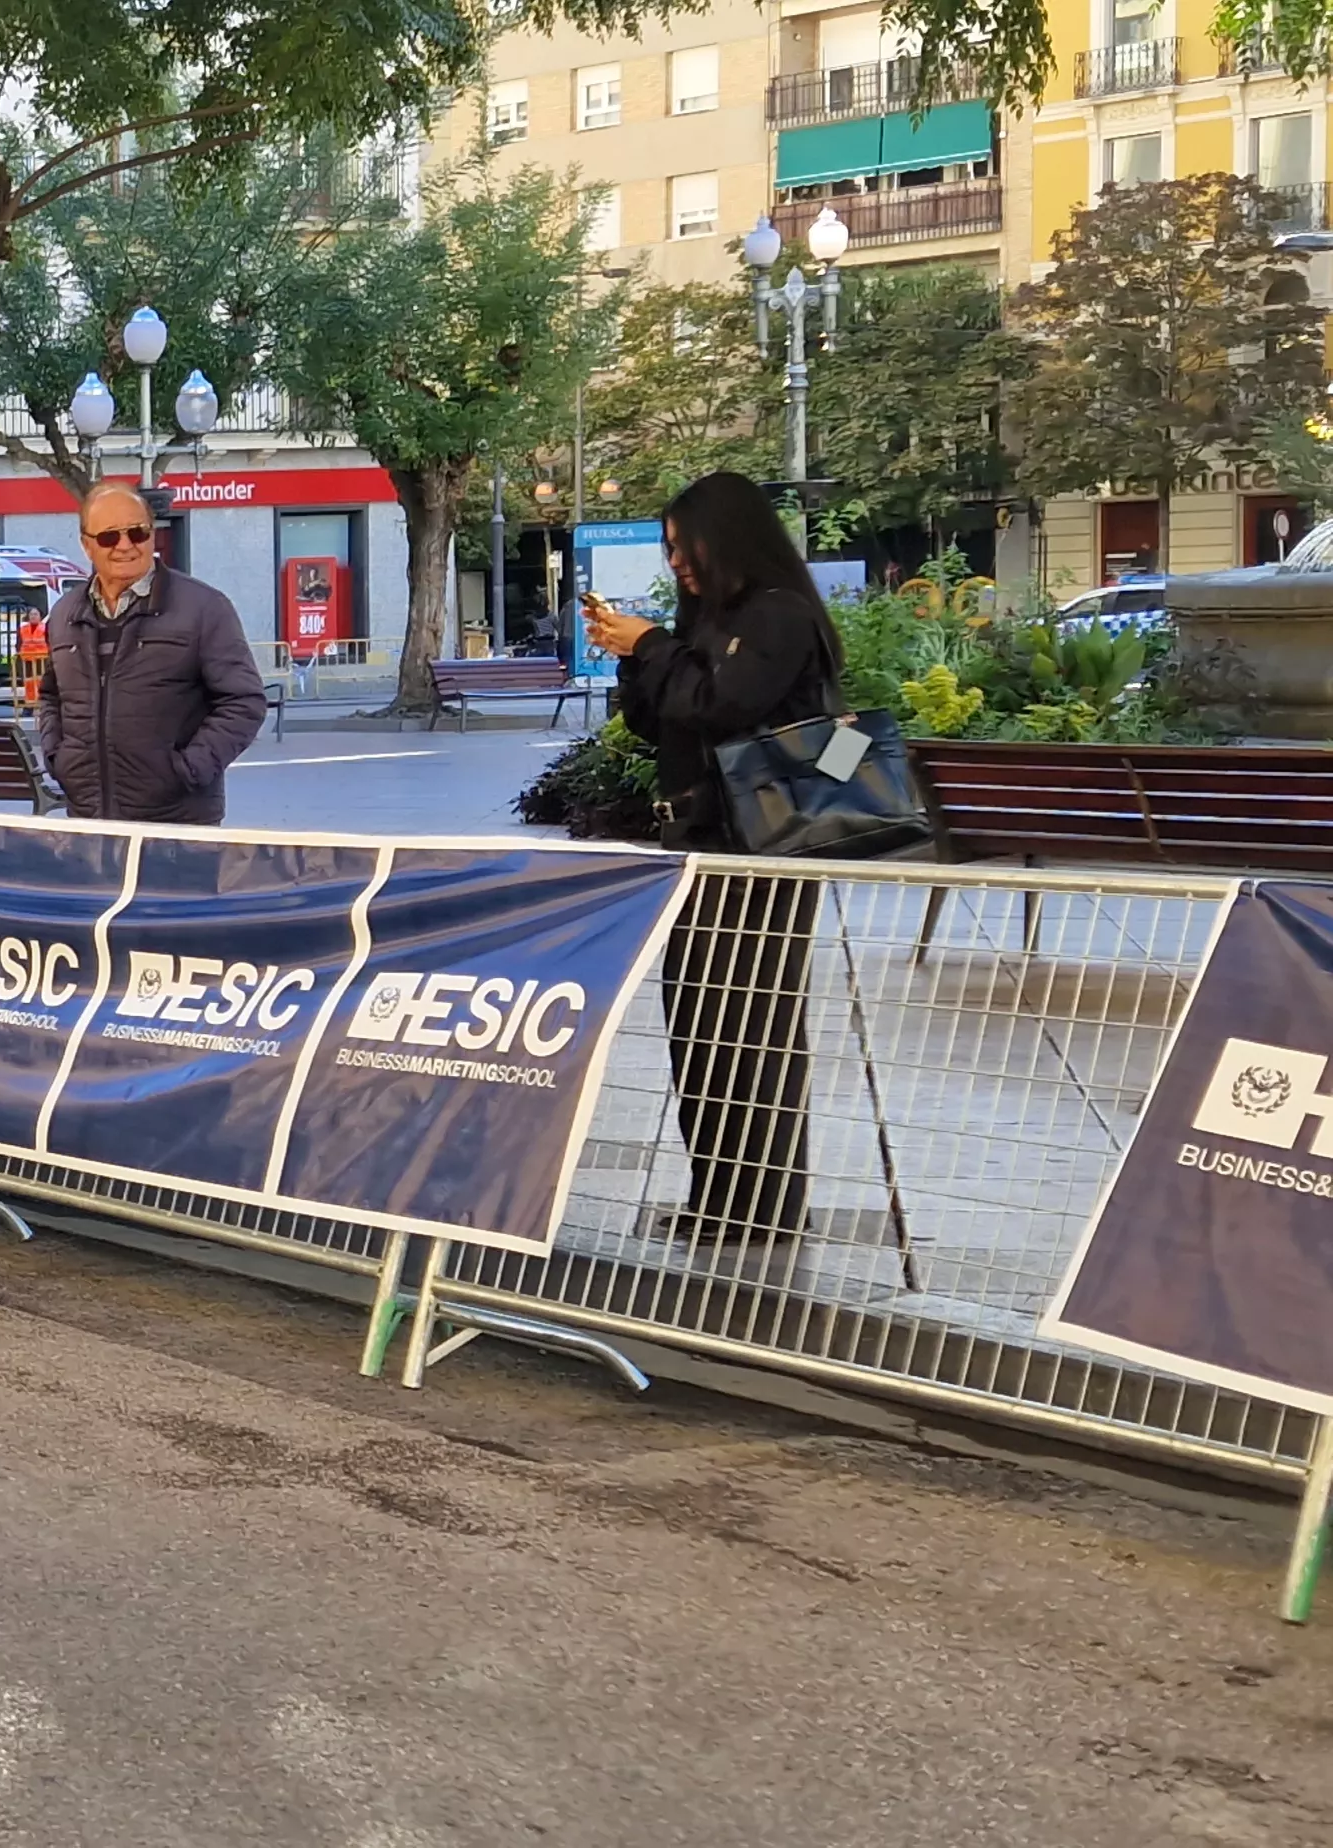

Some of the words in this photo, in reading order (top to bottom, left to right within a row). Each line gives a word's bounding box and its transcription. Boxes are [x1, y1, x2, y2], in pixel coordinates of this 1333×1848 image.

[584, 528, 635, 539] HUESCA
[160, 956, 316, 1031] ESIC
[402, 974, 586, 1058] ESIC
[102, 1022, 282, 1058] BUSINESS&MARKETINGSCHOOL
[335, 1048, 557, 1089] BUSINESS&MARKETINGSCHOOL
